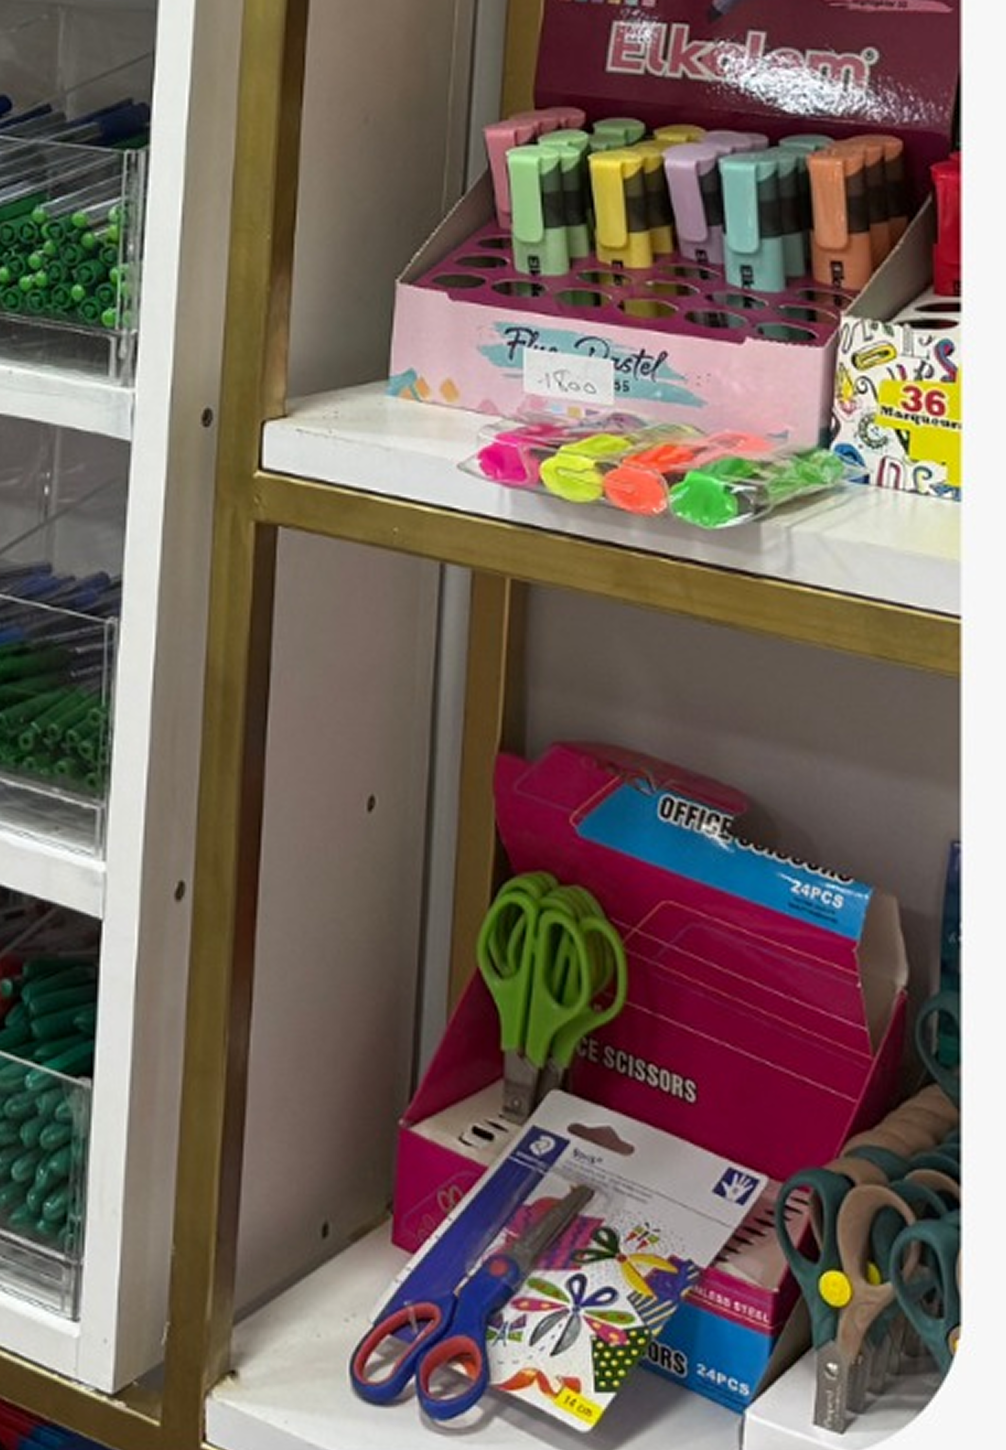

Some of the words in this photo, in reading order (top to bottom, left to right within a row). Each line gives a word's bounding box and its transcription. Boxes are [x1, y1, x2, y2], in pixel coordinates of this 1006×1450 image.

[900, 385, 948, 417] 36
[657, 793, 735, 843] OFFICE
[789, 878, 844, 910] 24PCS
[602, 1044, 698, 1104] SCISSORS
[732, 1298, 772, 1325] STEEL
[695, 1362, 751, 1397] 24PCS
